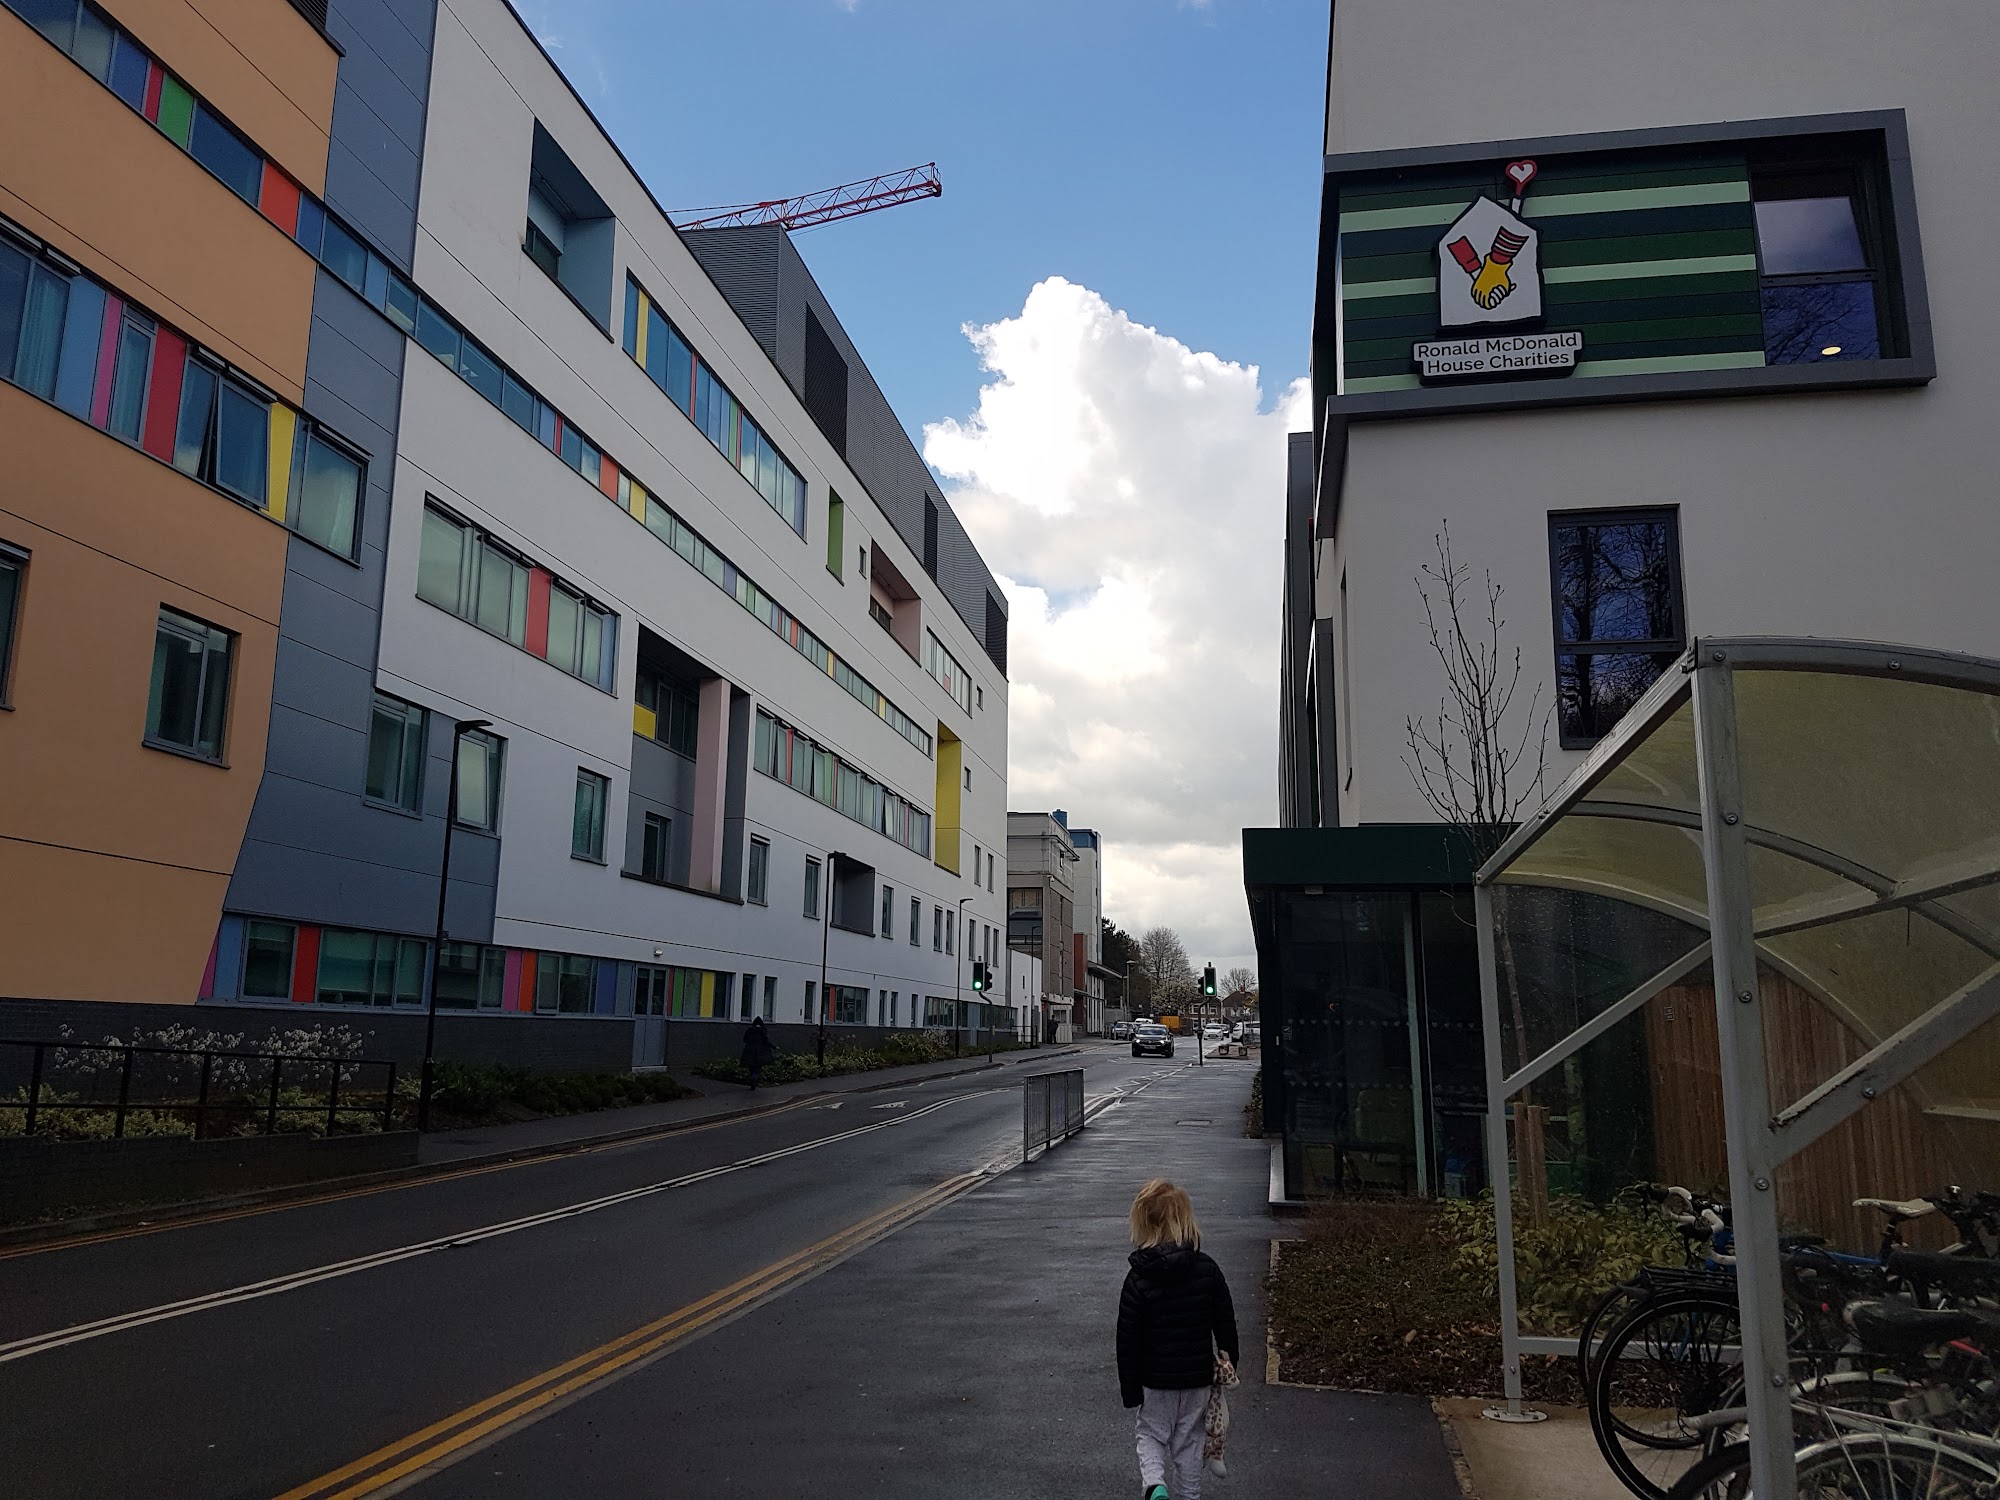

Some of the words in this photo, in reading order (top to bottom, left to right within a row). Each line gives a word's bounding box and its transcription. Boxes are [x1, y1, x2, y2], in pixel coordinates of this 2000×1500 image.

[1418, 341, 1480, 358] Ronald
[1486, 333, 1577, 353] McDonald
[1428, 360, 1485, 374] House
[1489, 352, 1570, 369] Charities
